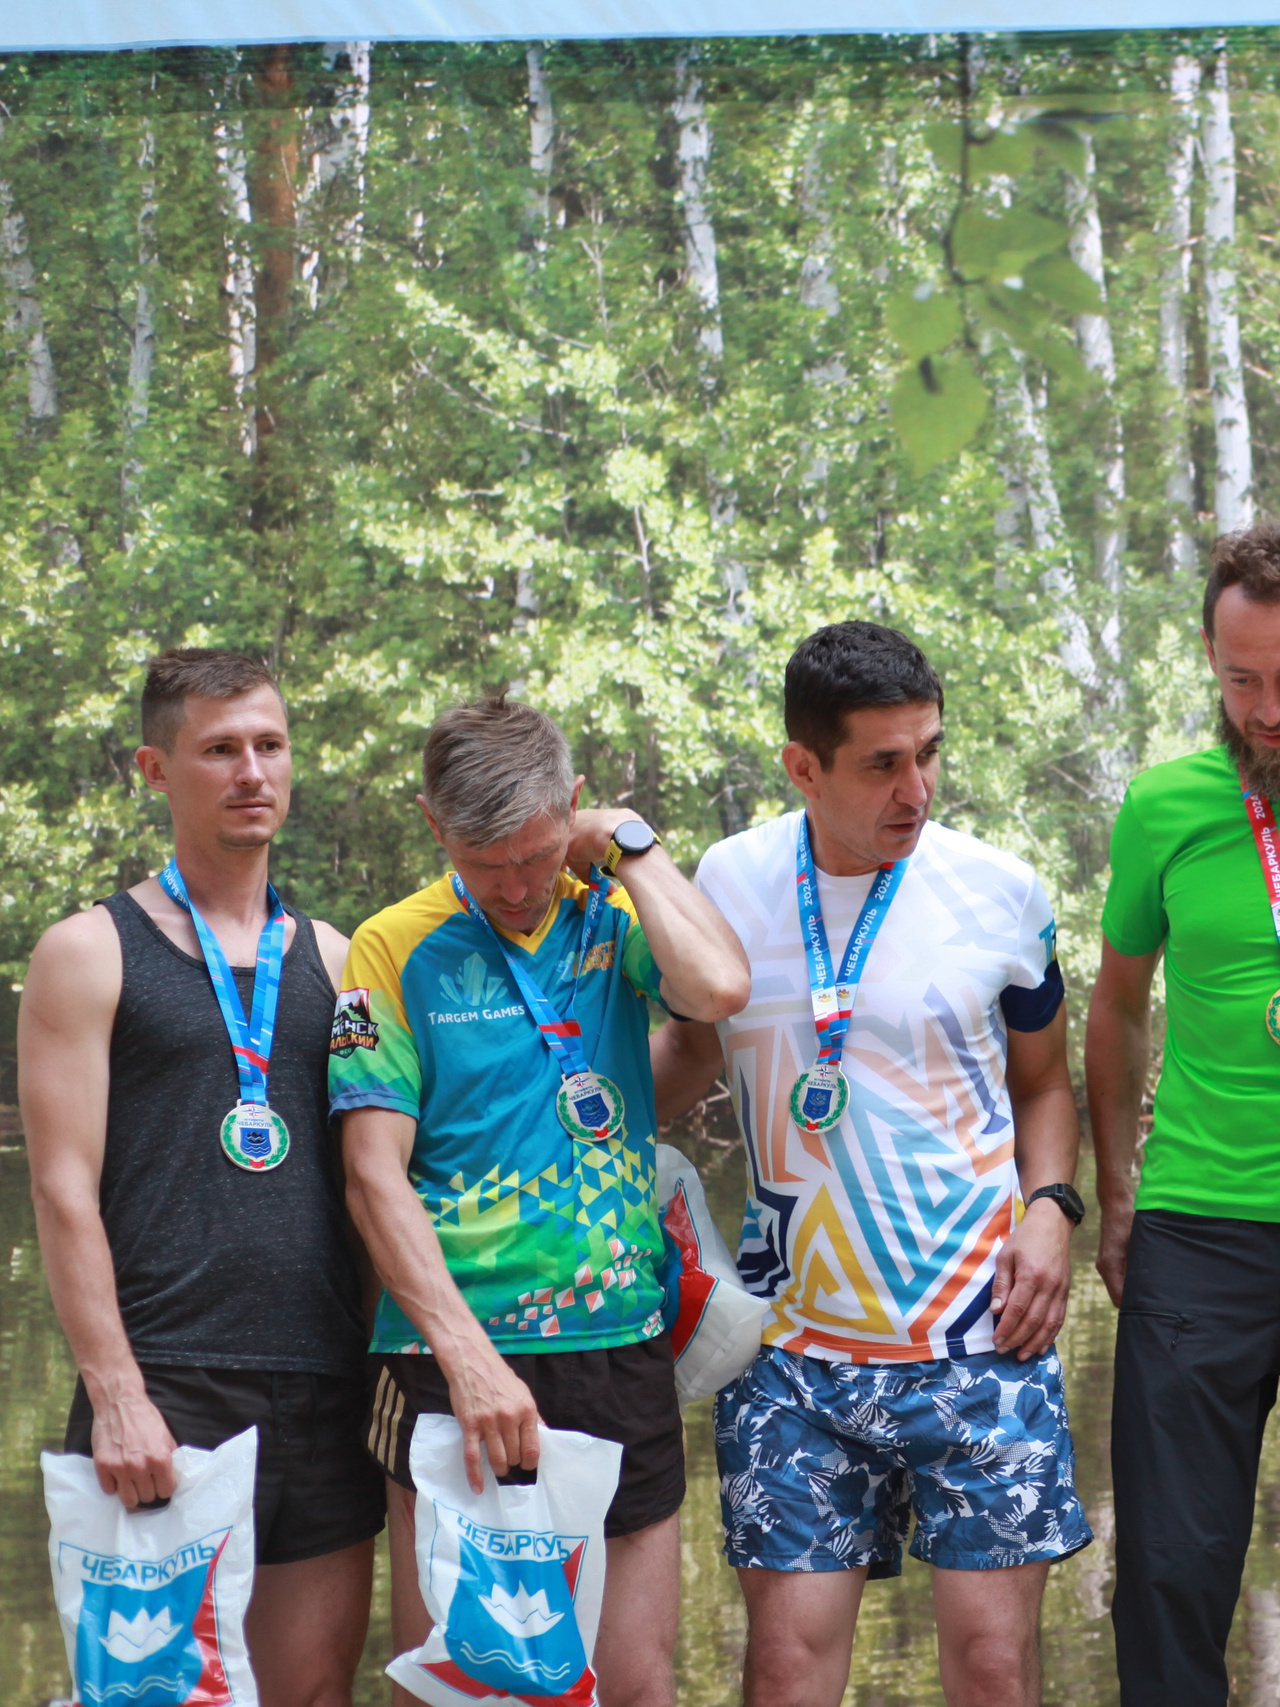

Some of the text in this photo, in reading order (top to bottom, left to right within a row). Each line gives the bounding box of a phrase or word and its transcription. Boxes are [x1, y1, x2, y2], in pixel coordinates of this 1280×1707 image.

[1250, 794, 1266, 820] 2024
[162, 864, 189, 907] ЧЕБАРКУ
[588, 891, 600, 920] 2024
[803, 878, 828, 985] ЧЕБАРКУЛЬ 2024
[845, 872, 894, 978] ЧЕБАРКУЛЬ 2024
[427, 1004, 525, 1026] TARGEM GAMES
[457, 1516, 571, 1563] ЧЕБАРКУЬ
[81, 1543, 217, 1586] ЧЕБАРКУЛЬ
